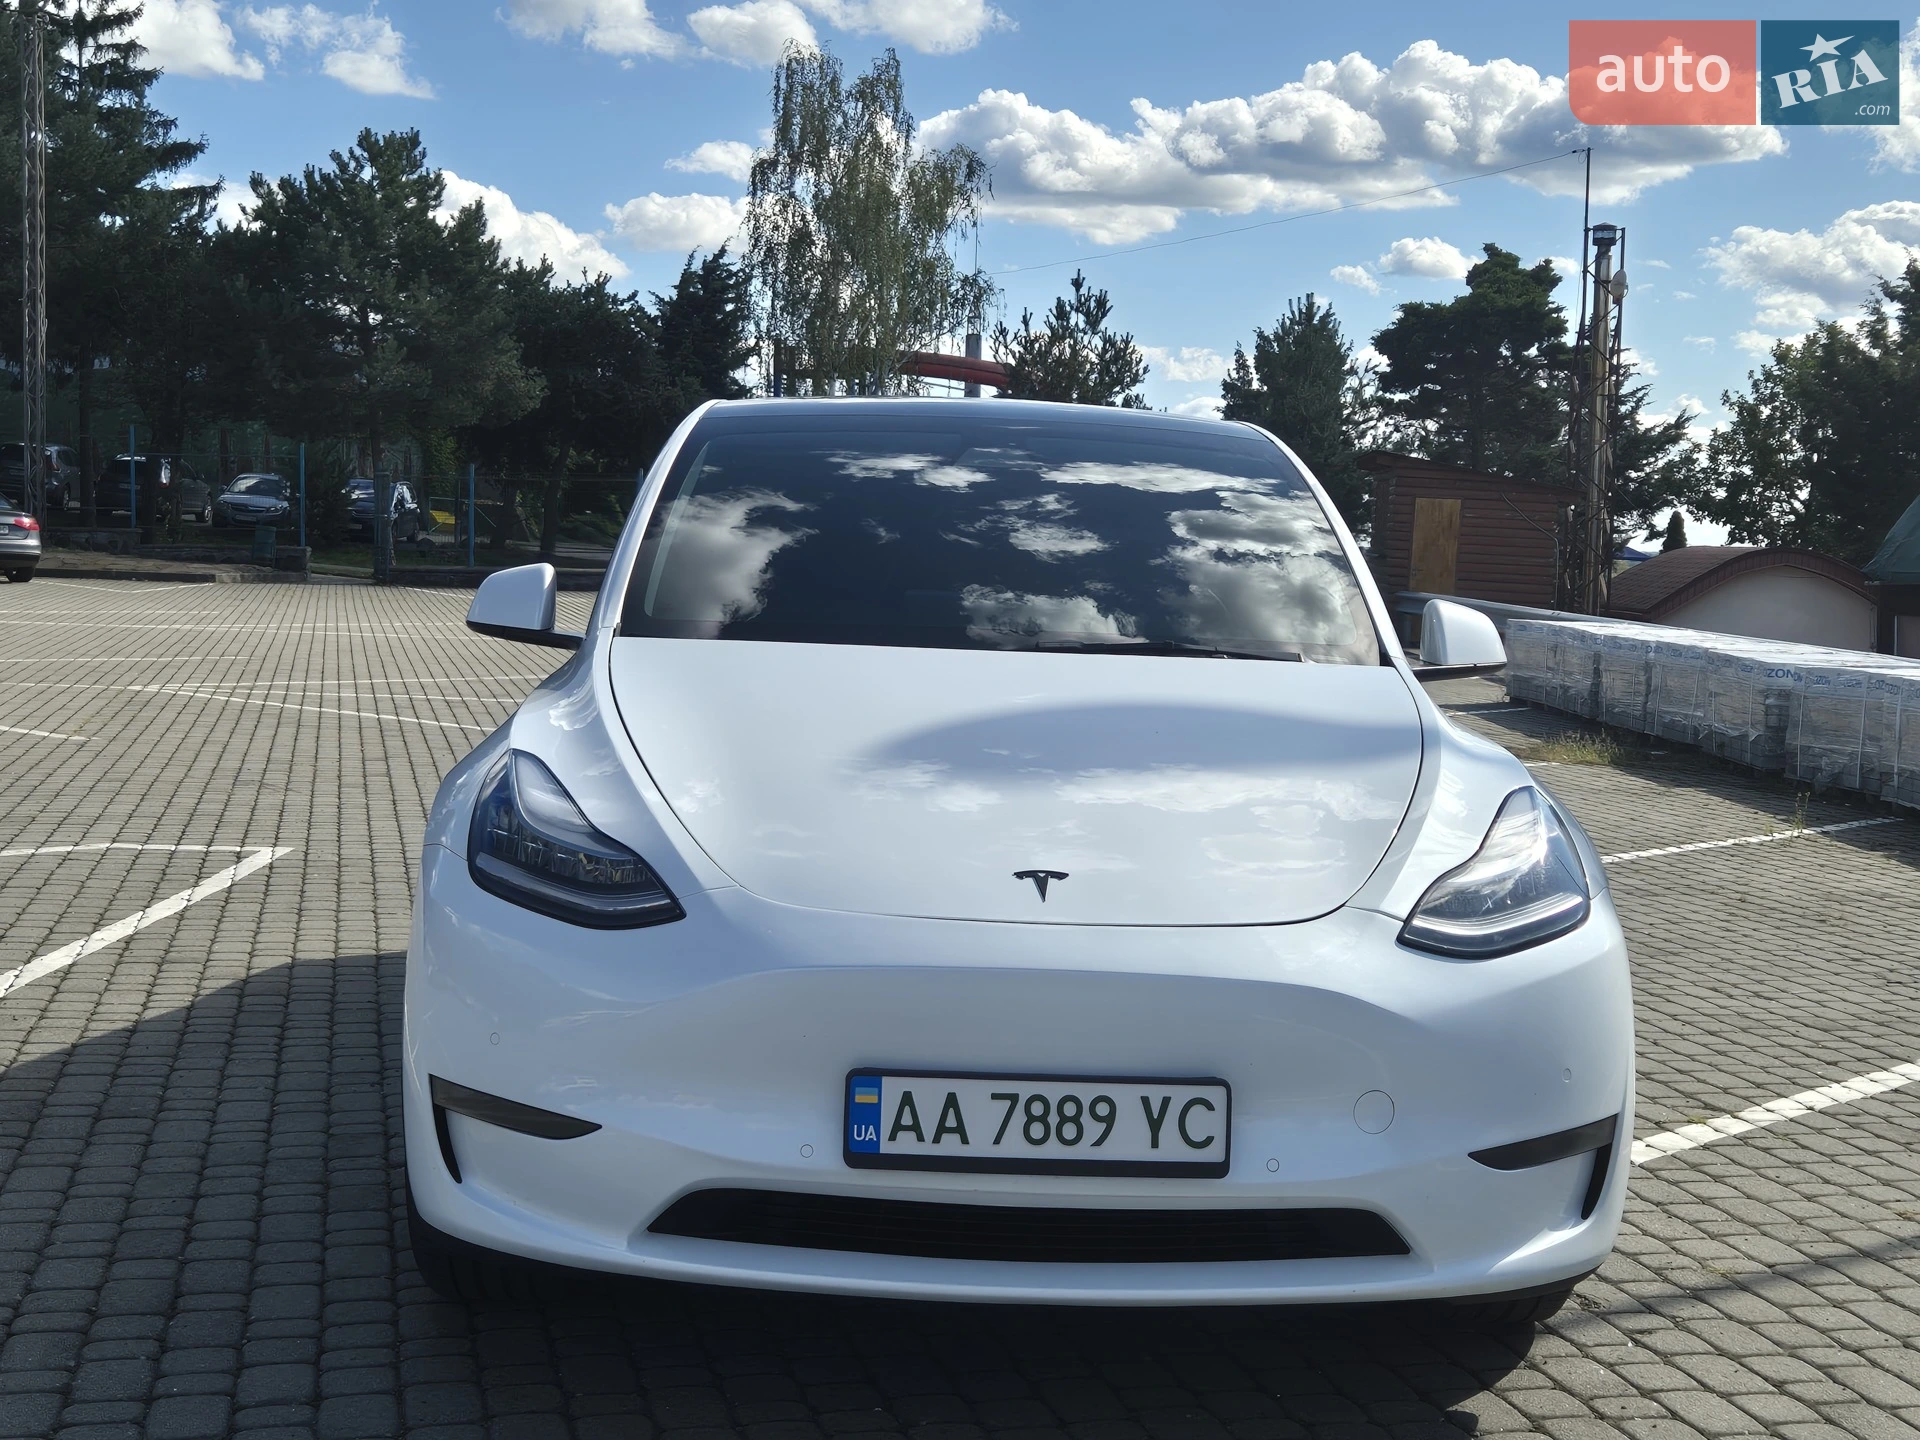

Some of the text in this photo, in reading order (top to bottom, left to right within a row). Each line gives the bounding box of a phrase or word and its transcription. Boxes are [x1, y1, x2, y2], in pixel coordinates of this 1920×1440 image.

[853, 1124, 877, 1142] UA
[887, 1090, 1216, 1150] AA 7889 YC
